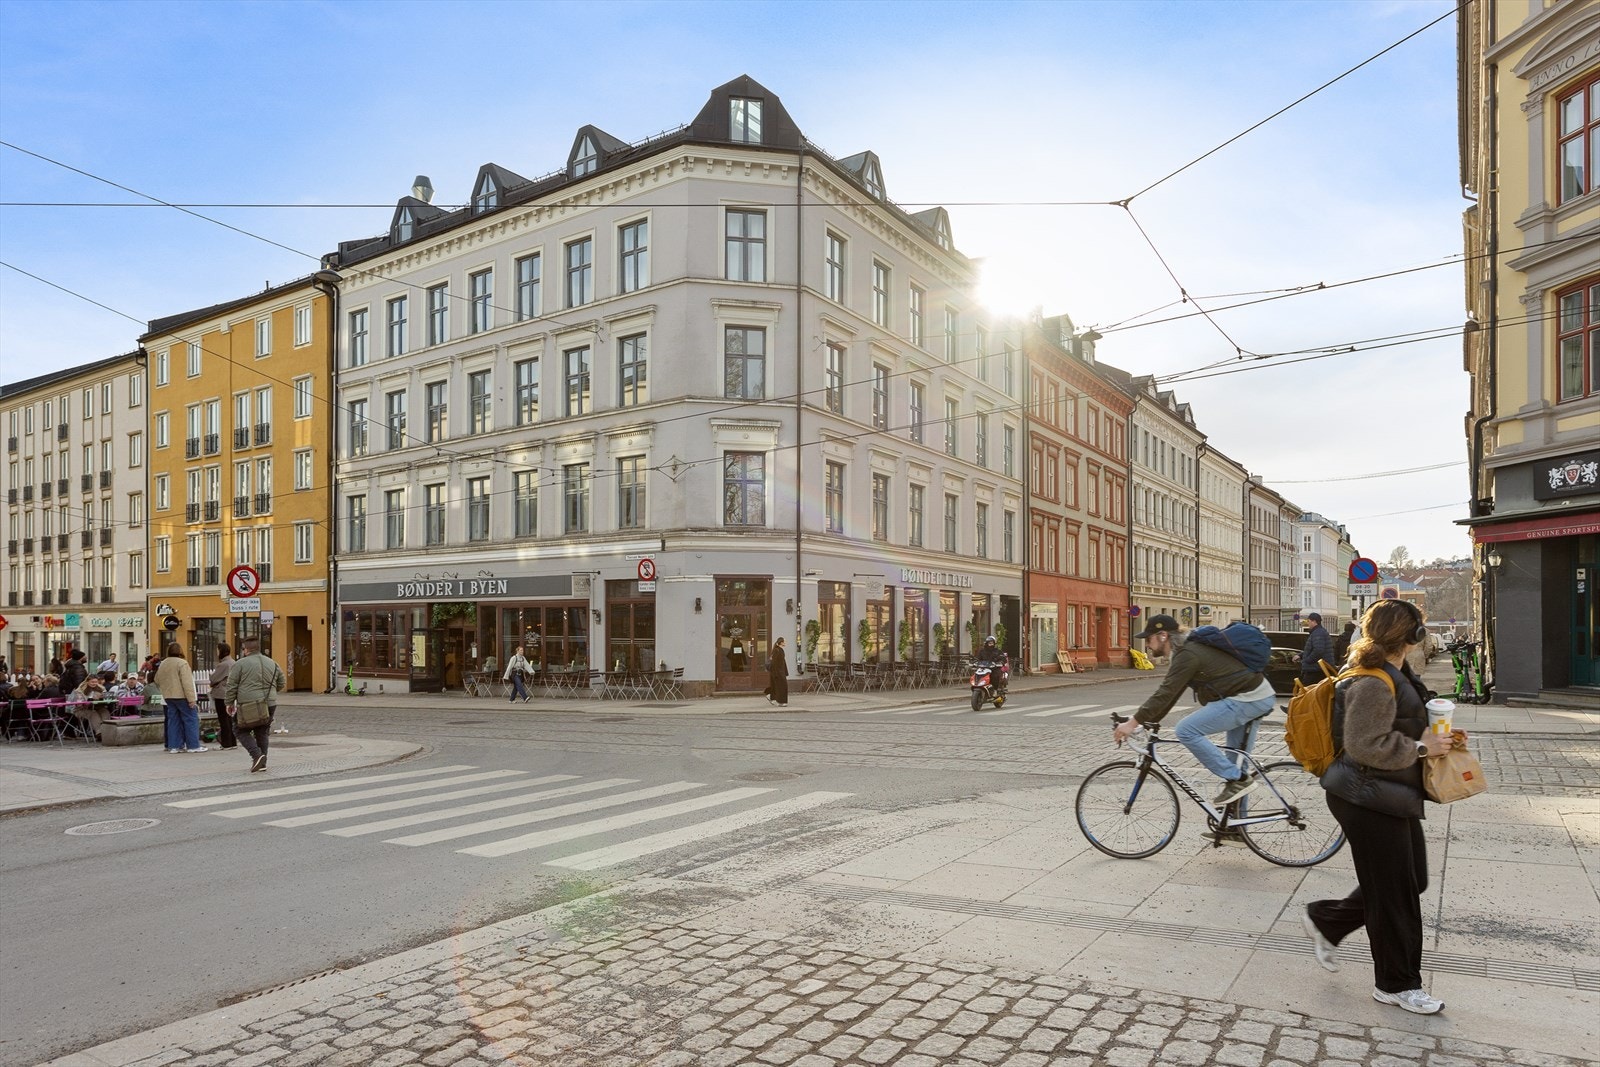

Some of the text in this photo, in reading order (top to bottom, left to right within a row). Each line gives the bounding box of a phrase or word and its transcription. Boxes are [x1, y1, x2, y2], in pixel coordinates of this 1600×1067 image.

[1530, 55, 1575, 92] ANNO
[1526, 529, 1560, 538] GENUINE
[901, 568, 974, 588] BØNDER I BYEN
[397, 580, 508, 597] BØNDER I BYEN
[1159, 764, 1206, 803] MERIDA
